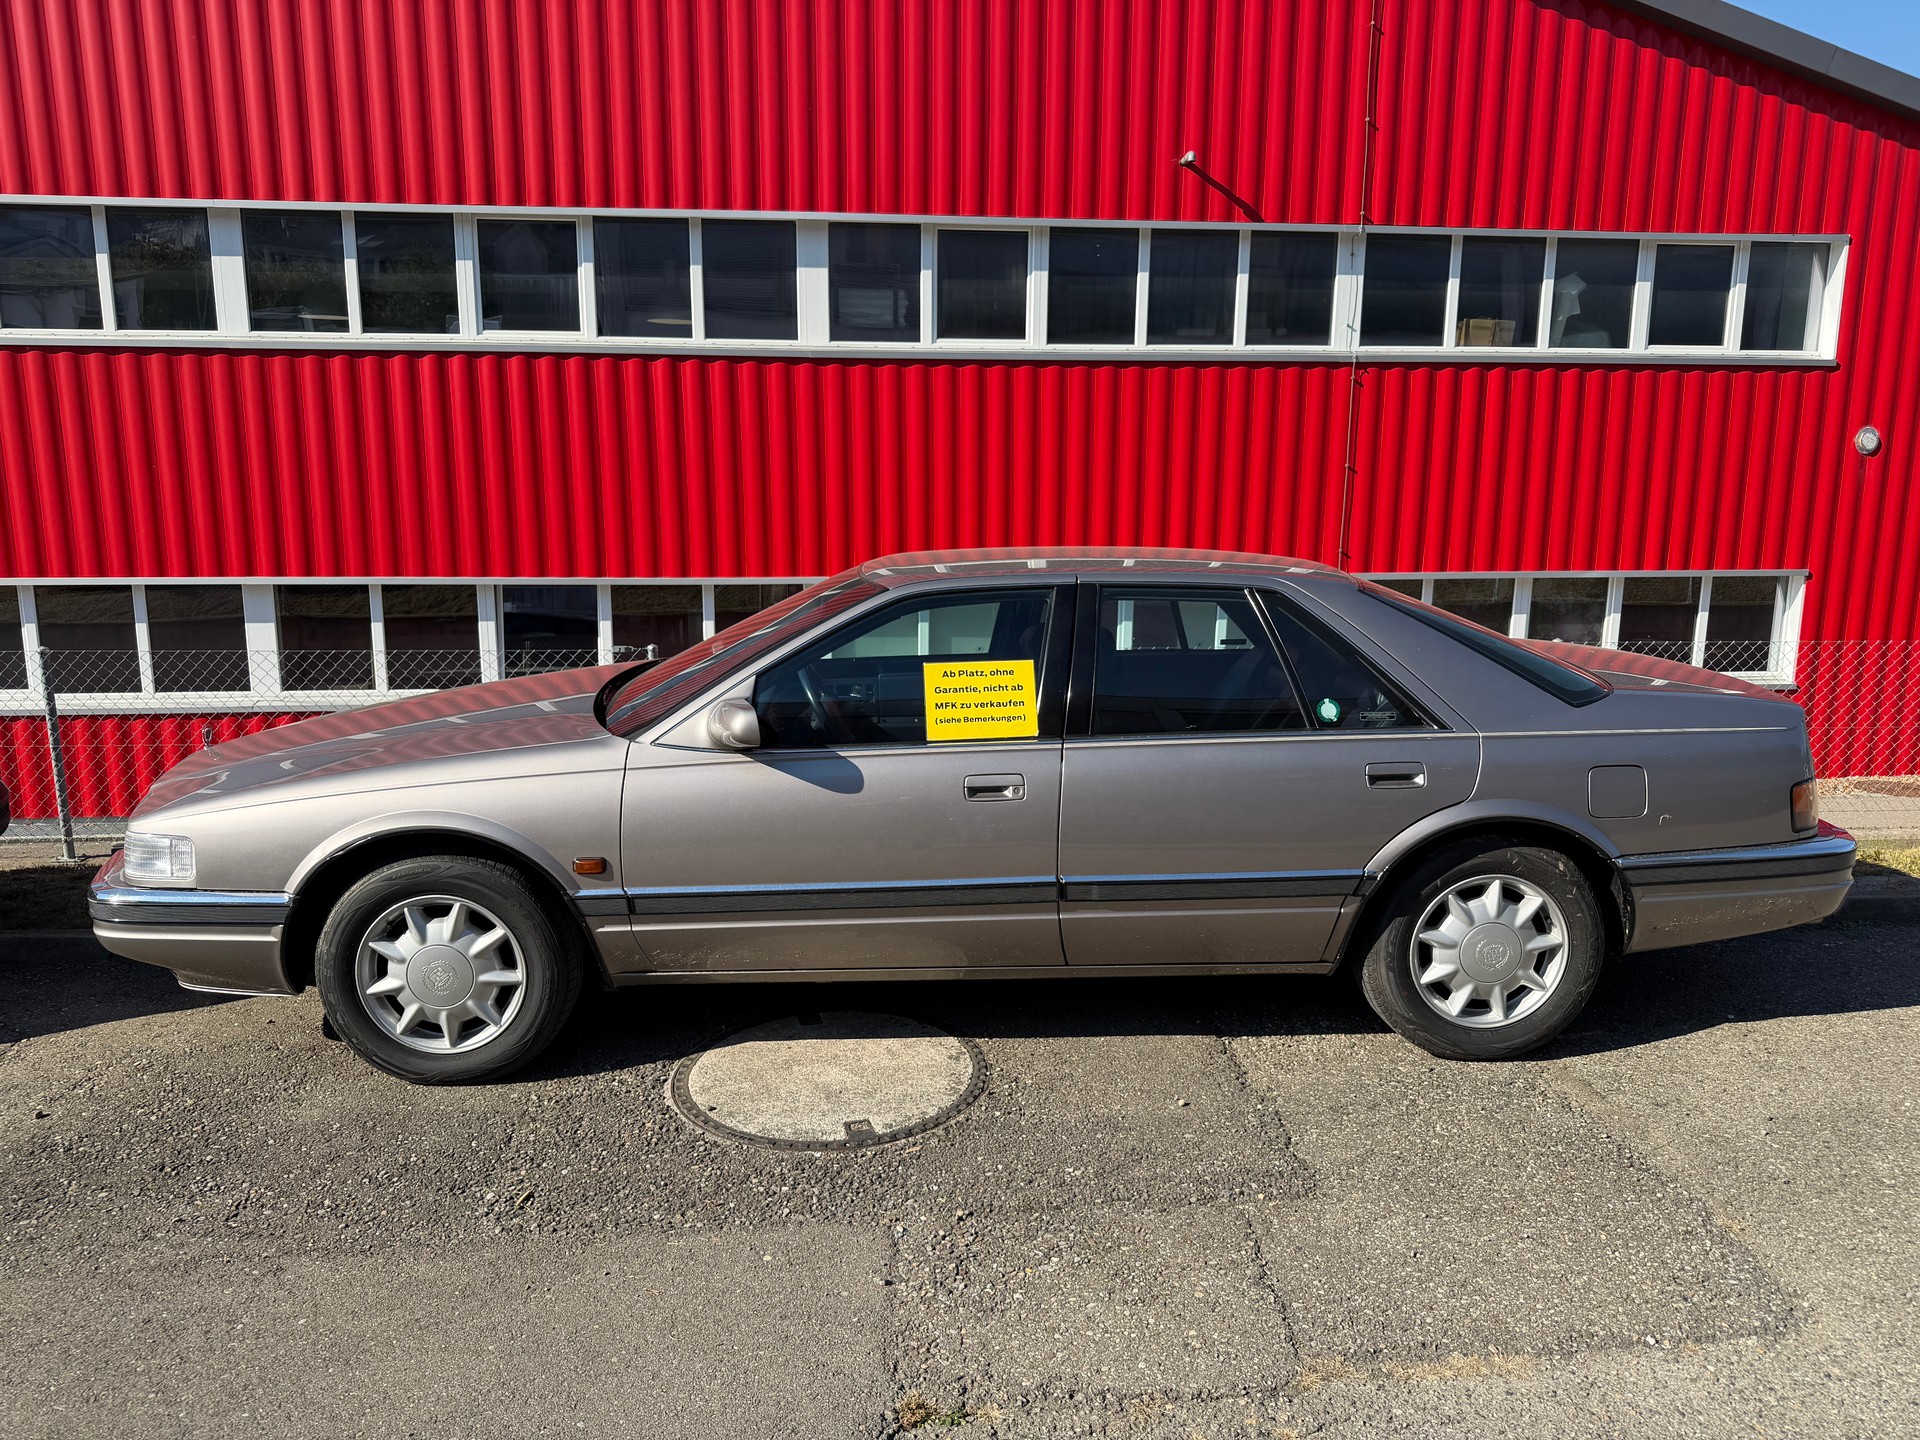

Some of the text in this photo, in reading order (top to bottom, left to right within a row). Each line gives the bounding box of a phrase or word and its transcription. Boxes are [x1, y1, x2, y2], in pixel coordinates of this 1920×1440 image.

[942, 669, 1015, 678] Ab Platz, ohne
[934, 684, 1024, 694] Garantie, nicht ab
[935, 702, 958, 710] MFK
[974, 699, 1025, 709] verkaufen
[935, 714, 1027, 725] (siehe Bemerkungen)
